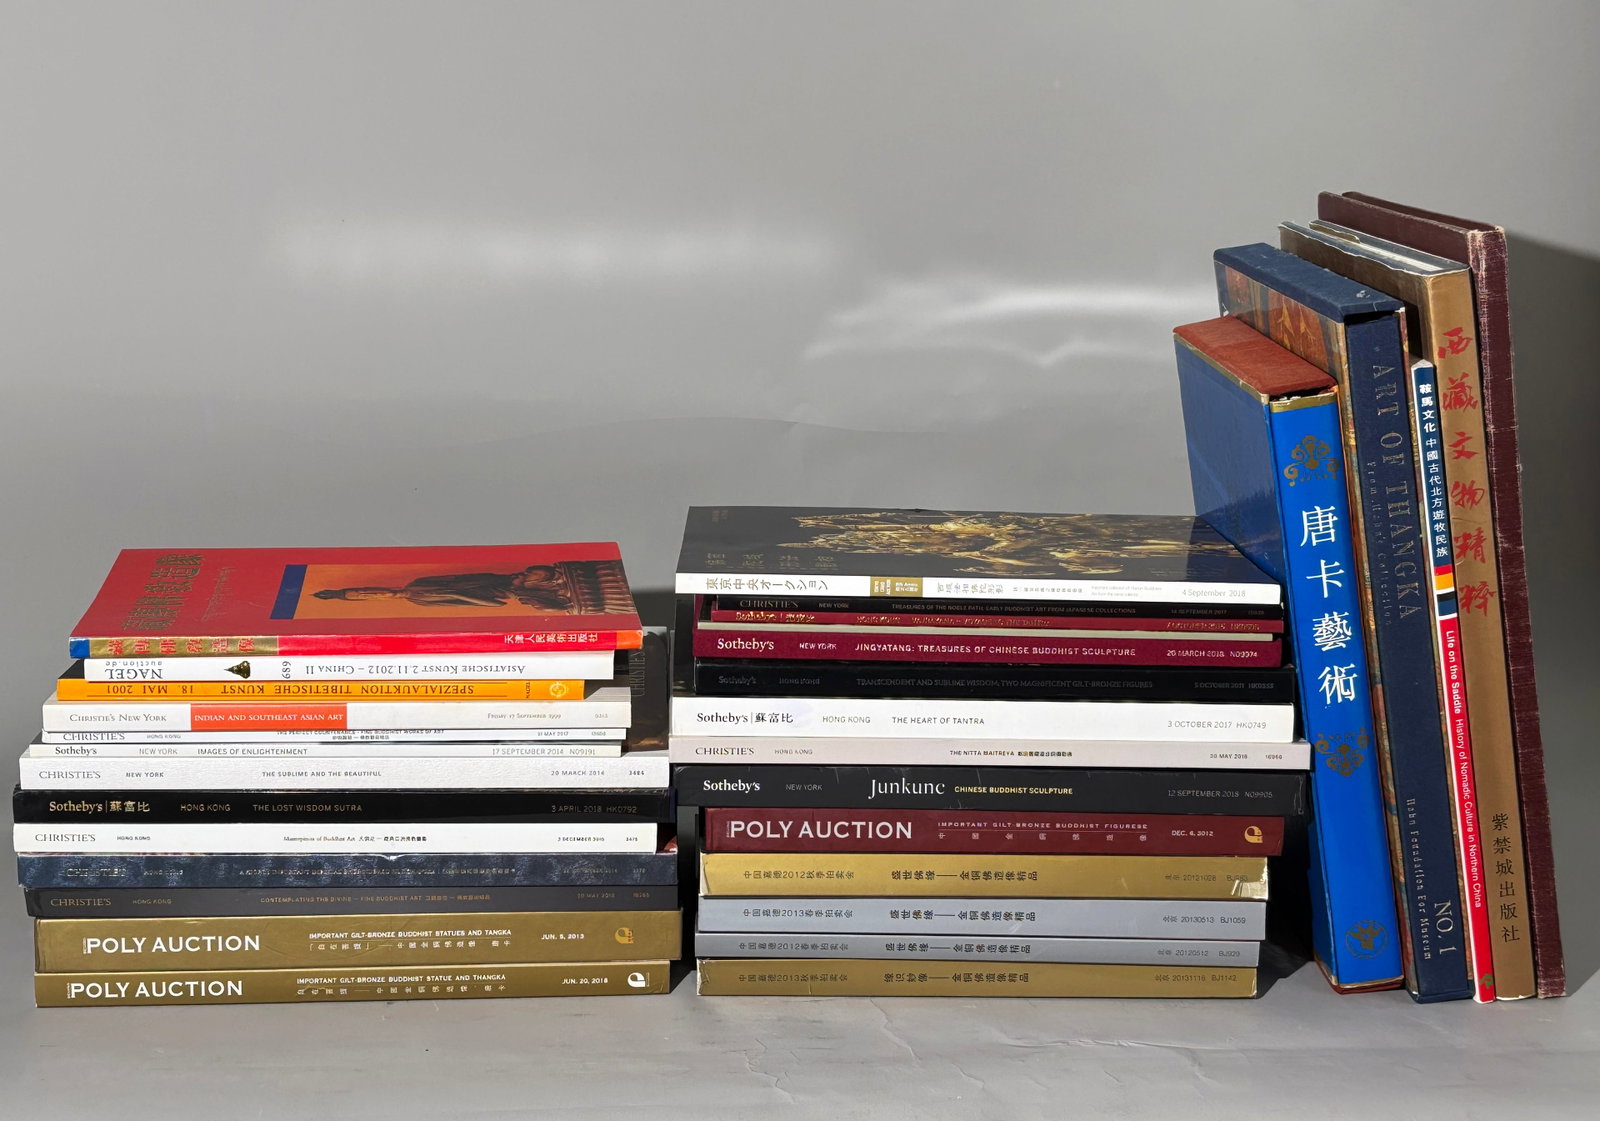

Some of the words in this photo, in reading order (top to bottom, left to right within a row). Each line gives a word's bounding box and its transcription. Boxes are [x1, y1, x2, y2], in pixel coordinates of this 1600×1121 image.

[1373, 364, 1400, 416] ART
[1419, 384, 1437, 432] 鞍馬文化
[1380, 432, 1405, 465] OF
[1438, 327, 1496, 617] 西藏文物精粹
[1425, 438, 1449, 558] 中國古代北方遊牧民族
[1385, 480, 1422, 619] THANGKA
[706, 577, 829, 590] 東京中央オークション
[1187, 589, 1227, 598] September
[1228, 590, 1246, 598] 2018
[1300, 505, 1358, 705] 唐卡藝術
[504, 632, 598, 645] 天津人民美術出版社
[1445, 630, 1455, 649] Life
[717, 638, 775, 653] Sotheby's
[799, 642, 817, 650] NEW
[817, 642, 838, 650] YORK
[854, 643, 916, 652] JINGYATANG:
[917, 644, 972, 653] TREASURES
[973, 645, 986, 653] OF
[988, 646, 1030, 654] CHINESE
[1032, 647, 1080, 655] BUDDHIST
[1081, 647, 1136, 656] SCULPTURE
[1166, 649, 1177, 657] 20
[1177, 649, 1205, 657] MARCH
[1447, 650, 1456, 663] on
[104, 660, 163, 668] auction.de
[281, 660, 291, 680] 689
[368, 665, 419, 674] 2.11.2012
[104, 669, 163, 680] NAGEL
[1449, 664, 1458, 680] the
[106, 685, 133, 694] 2001
[141, 685, 168, 694] MAI
[181, 685, 194, 694] 18.
[220, 685, 265, 694] KUNST
[275, 685, 352, 695] TIBETISCHE
[361, 685, 475, 695] SPEZIALAUKTION
[1451, 682, 1462, 715] Saddle
[248, 713, 298, 721] SOUTHEAST
[300, 713, 325, 721] ASIAN
[696, 712, 749, 724] Sotheby's
[755, 712, 794, 723] 蘇富比
[952, 717, 985, 725] TANTRA
[1167, 720, 1173, 728] 3
[1214, 721, 1232, 729] 2017
[63, 732, 125, 741] CHRISTIE'S
[1455, 718, 1466, 750] History
[55, 746, 98, 756] Sotheby's
[695, 747, 755, 756] CHRISTIE'S
[1458, 751, 1467, 761] of
[39, 770, 101, 779] CHRISTIE'S
[1460, 762, 1472, 800] Nomadic
[703, 779, 761, 793] Sotheby's
[867, 778, 946, 800] Junkunc
[989, 786, 1028, 794] BUDDHIST
[1029, 787, 1073, 795] SCULPTURE
[1167, 789, 1176, 797] 12
[1176, 789, 1221, 797] SEPTEMBER
[1222, 790, 1239, 798] 2018
[49, 801, 103, 814] Sotheby's
[109, 801, 150, 812] 蘇富比
[252, 804, 270, 812] THE
[271, 804, 294, 812] LOST
[296, 804, 332, 812] WISDOM
[333, 804, 363, 812] SUTRA
[558, 805, 582, 813] APRIL
[606, 806, 637, 814] HK0792
[1463, 801, 1475, 833] Culture
[730, 820, 794, 838] POLY
[798, 821, 912, 839] AUCTION
[1171, 829, 1189, 837] DEC.
[35, 834, 96, 842] CHRISTIE'S
[1467, 834, 1475, 842] in
[1468, 844, 1480, 882] Northern
[743, 870, 855, 879] 中国嘉德2012秋季拍卖会
[1491, 813, 1520, 943] 紫禁城出版社
[1411, 830, 1425, 891] Foundation
[1419, 918, 1432, 960] Museum
[1472, 883, 1482, 908] China
[50, 898, 112, 907] CHRISTIE'S
[743, 908, 853, 918] 中国嘉德2013春季拍卖会
[87, 937, 147, 954] POLY
[151, 935, 260, 953] AUCTION
[739, 943, 849, 951] 中国嘉德2012春季拍卖会
[738, 974, 848, 983] 中国嘉德2013秋季拍卖会
[70, 982, 130, 998] POLY
[135, 980, 243, 997] AUCTION
